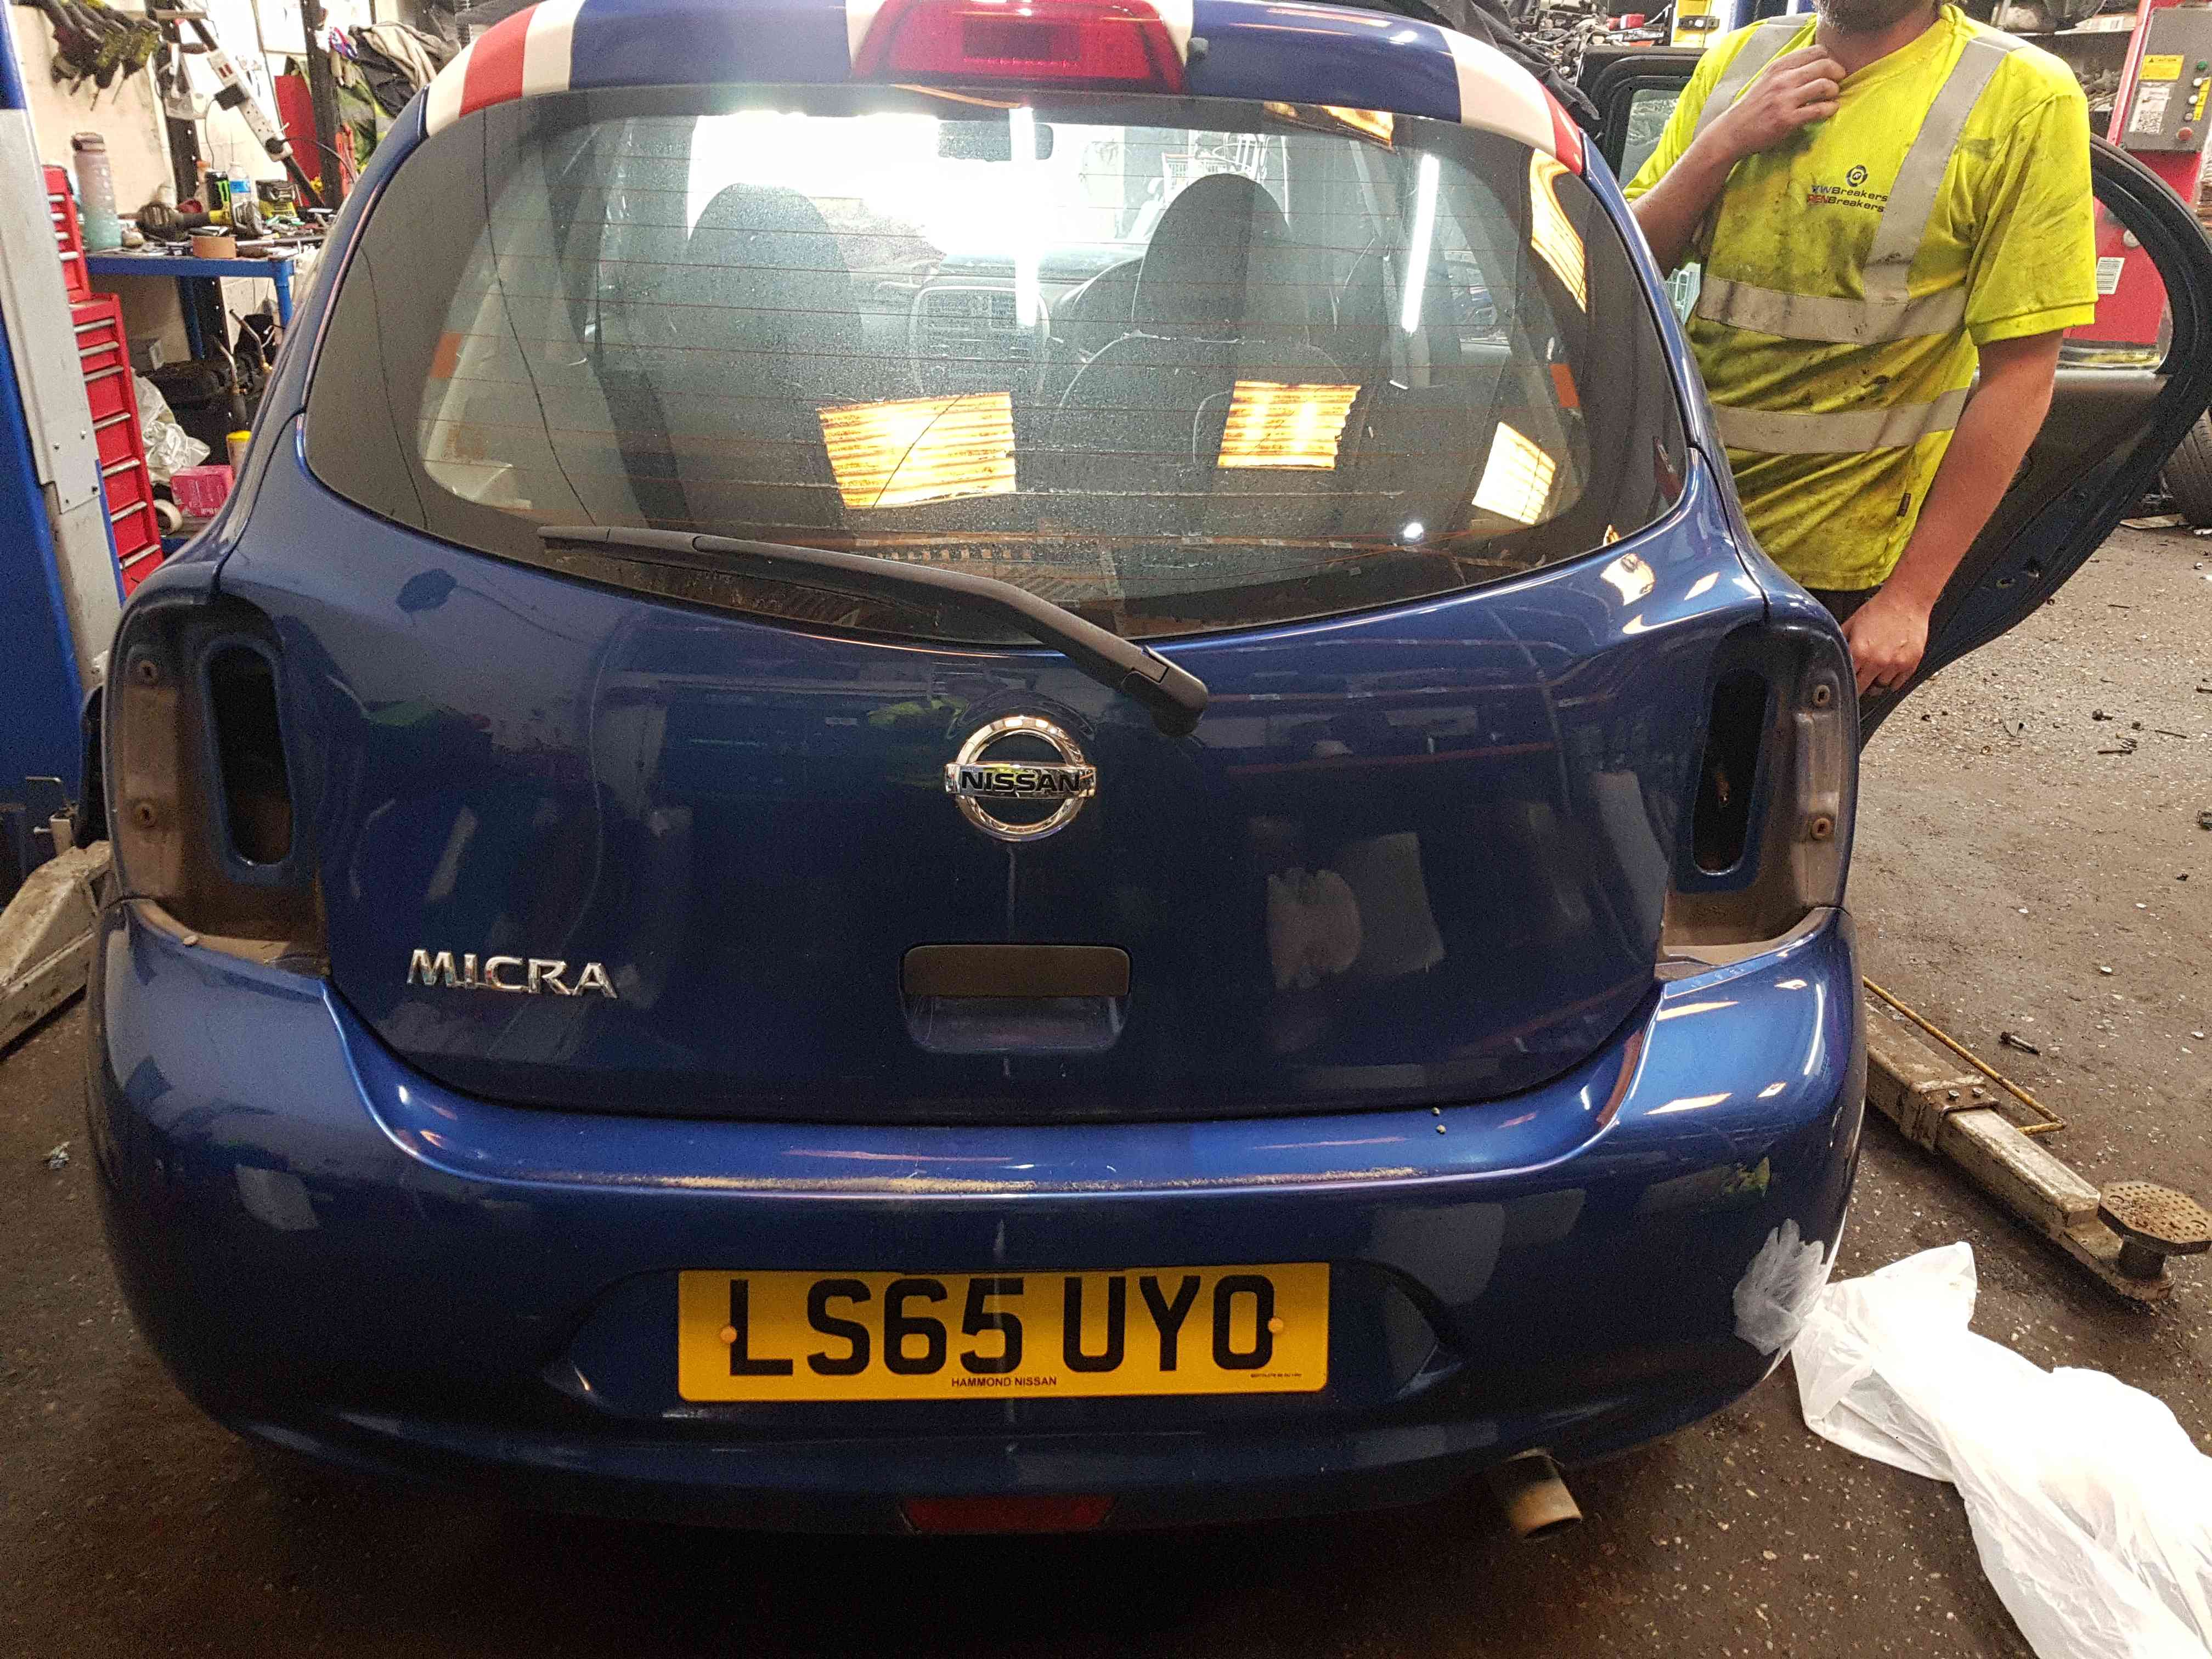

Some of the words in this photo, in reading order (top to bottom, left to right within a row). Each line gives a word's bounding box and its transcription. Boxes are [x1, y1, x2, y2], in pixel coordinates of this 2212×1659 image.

[961, 771, 1080, 792] NISSAN
[407, 949, 618, 998] MICRA
[730, 1276, 1025, 1376] LS65
[1062, 1274, 1275, 1373] UYO
[951, 1377, 1011, 1387] HAMMOND
[1014, 1376, 1057, 1386] NISSAN
